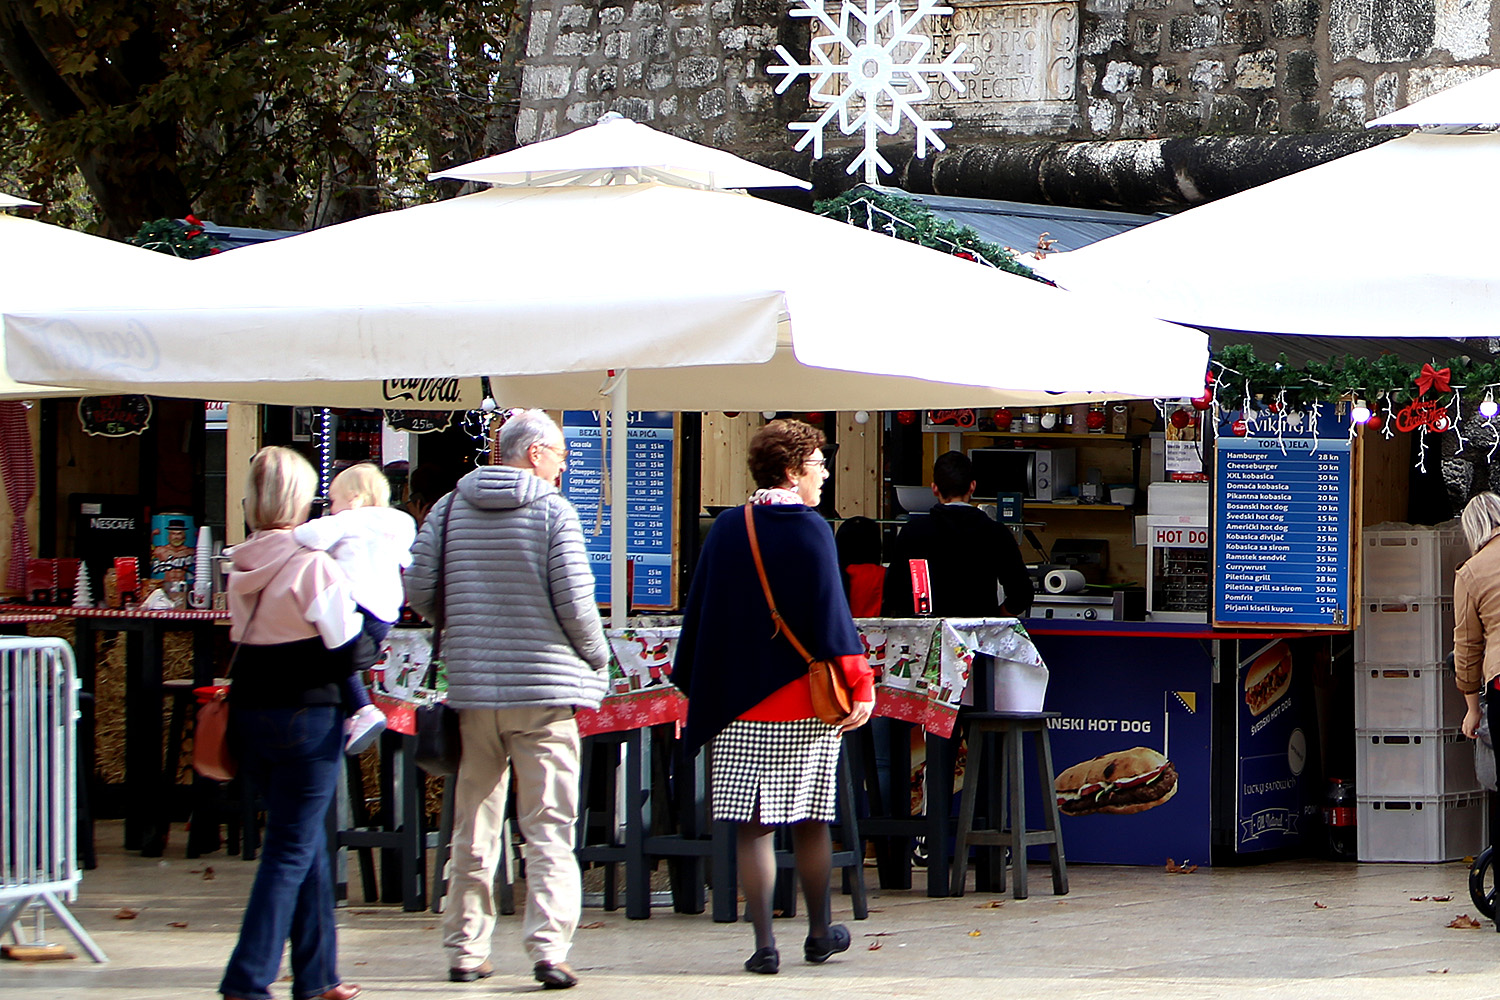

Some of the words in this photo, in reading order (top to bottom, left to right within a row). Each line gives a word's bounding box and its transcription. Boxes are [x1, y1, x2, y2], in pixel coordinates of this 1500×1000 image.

[1288, 440, 1309, 449] JELA
[1227, 452, 1268, 462] Hamburger
[1227, 463, 1278, 472] Cheeseburger
[1274, 503, 1288, 513] dog
[1269, 514, 1284, 523] dog
[1274, 524, 1288, 533] dog
[1156, 530, 1183, 543] HOT
[1189, 530, 1207, 543] DO
[1259, 534, 1284, 543] divljač
[1255, 574, 1270, 583] grill
[1254, 584, 1270, 593] grill
[1225, 604, 1249, 613] Pirjani
[1271, 604, 1293, 614] kupus
[1046, 718, 1084, 730] ANSKI
[1088, 719, 1118, 731] HOT
[1121, 720, 1151, 733] DOG
